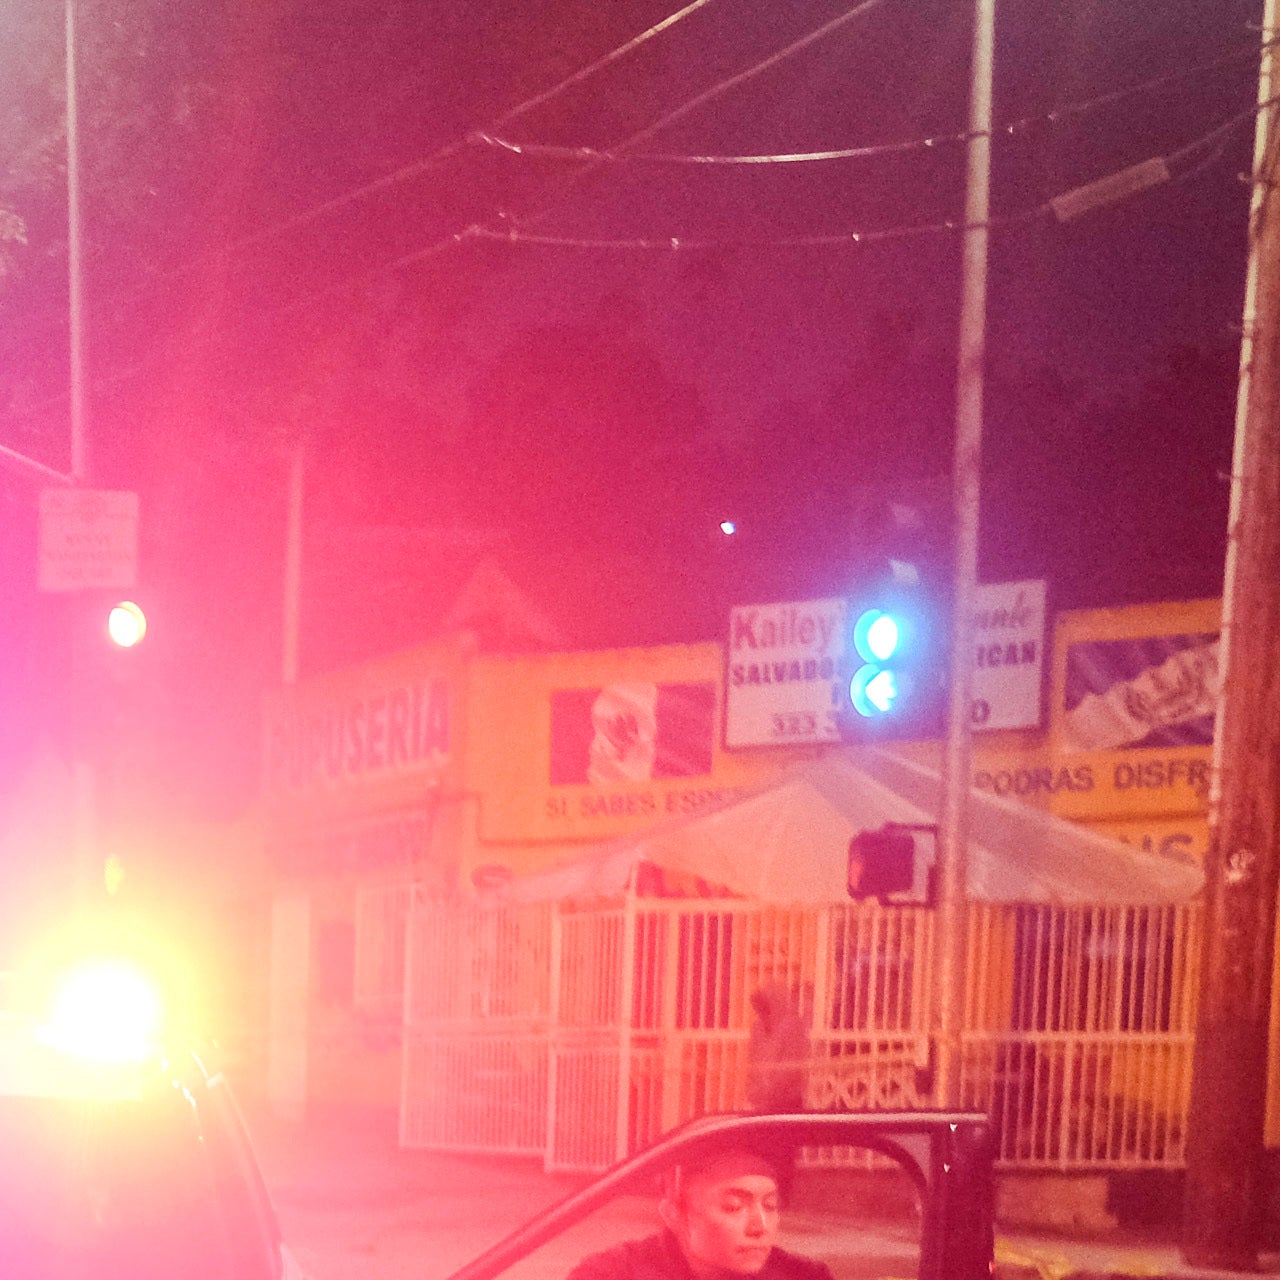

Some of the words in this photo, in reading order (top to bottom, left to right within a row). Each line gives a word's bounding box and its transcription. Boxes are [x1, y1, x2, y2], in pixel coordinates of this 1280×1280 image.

[976, 641, 1036, 668] ICAN
[545, 797, 567, 818] SI
[580, 793, 655, 817] SABES
[1113, 758, 1210, 790] DISFR
